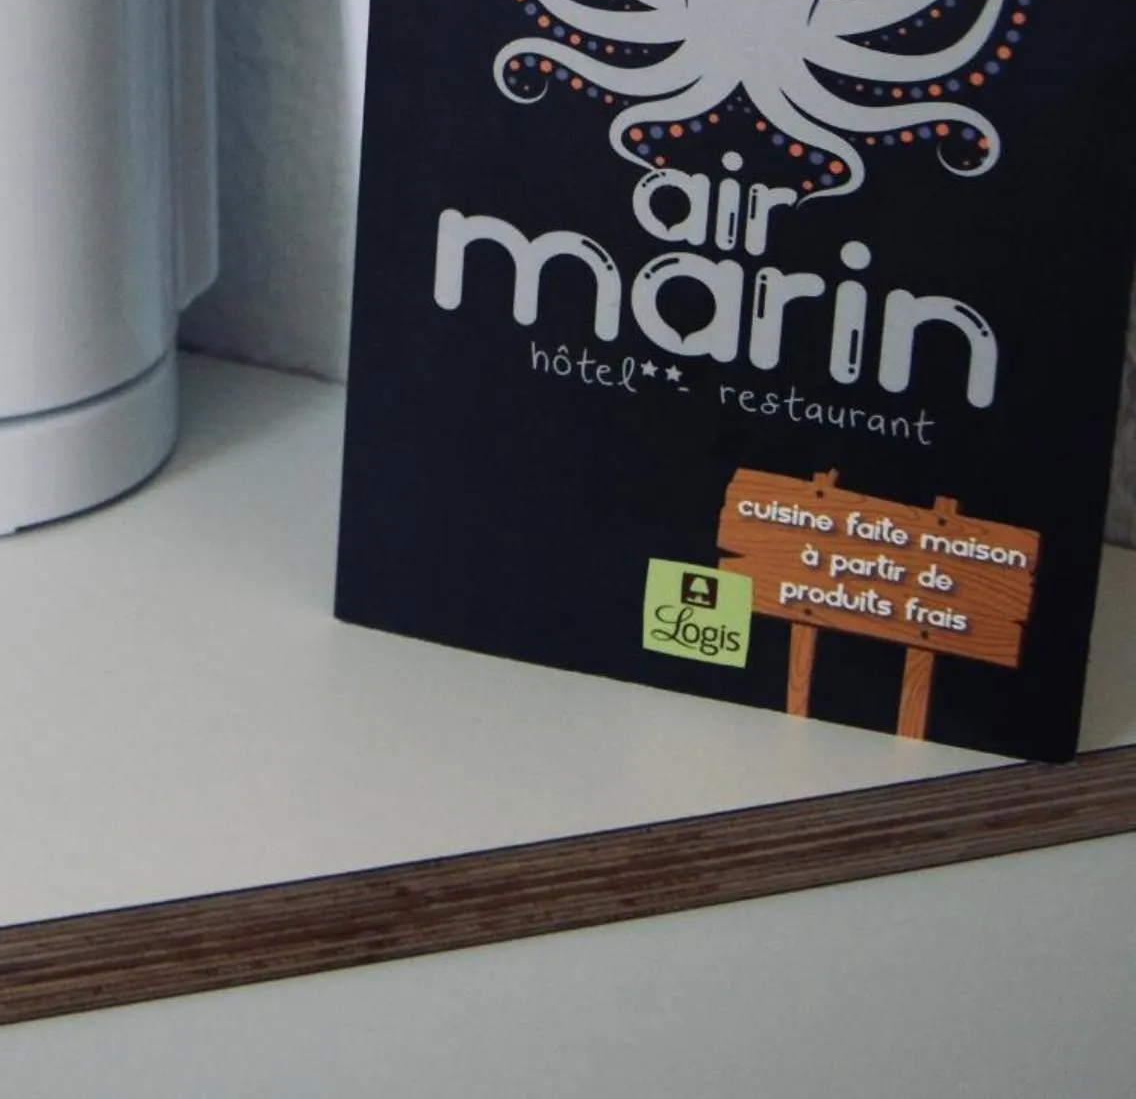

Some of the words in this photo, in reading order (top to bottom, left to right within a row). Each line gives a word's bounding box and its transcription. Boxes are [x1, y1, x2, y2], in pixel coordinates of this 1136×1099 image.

[632, 151, 798, 256] air
[433, 208, 999, 409] marin
[530, 341, 638, 393] hôtel
[720, 382, 936, 446] restaurant
[738, 500, 833, 533] cuisine
[846, 512, 908, 547] faite
[920, 533, 1028, 569] maison
[801, 544, 819, 567] à
[829, 553, 906, 583] partir
[918, 563, 954, 592] de
[650, 604, 741, 656] Logis
[779, 580, 893, 617] produits
[905, 597, 968, 632] frais
